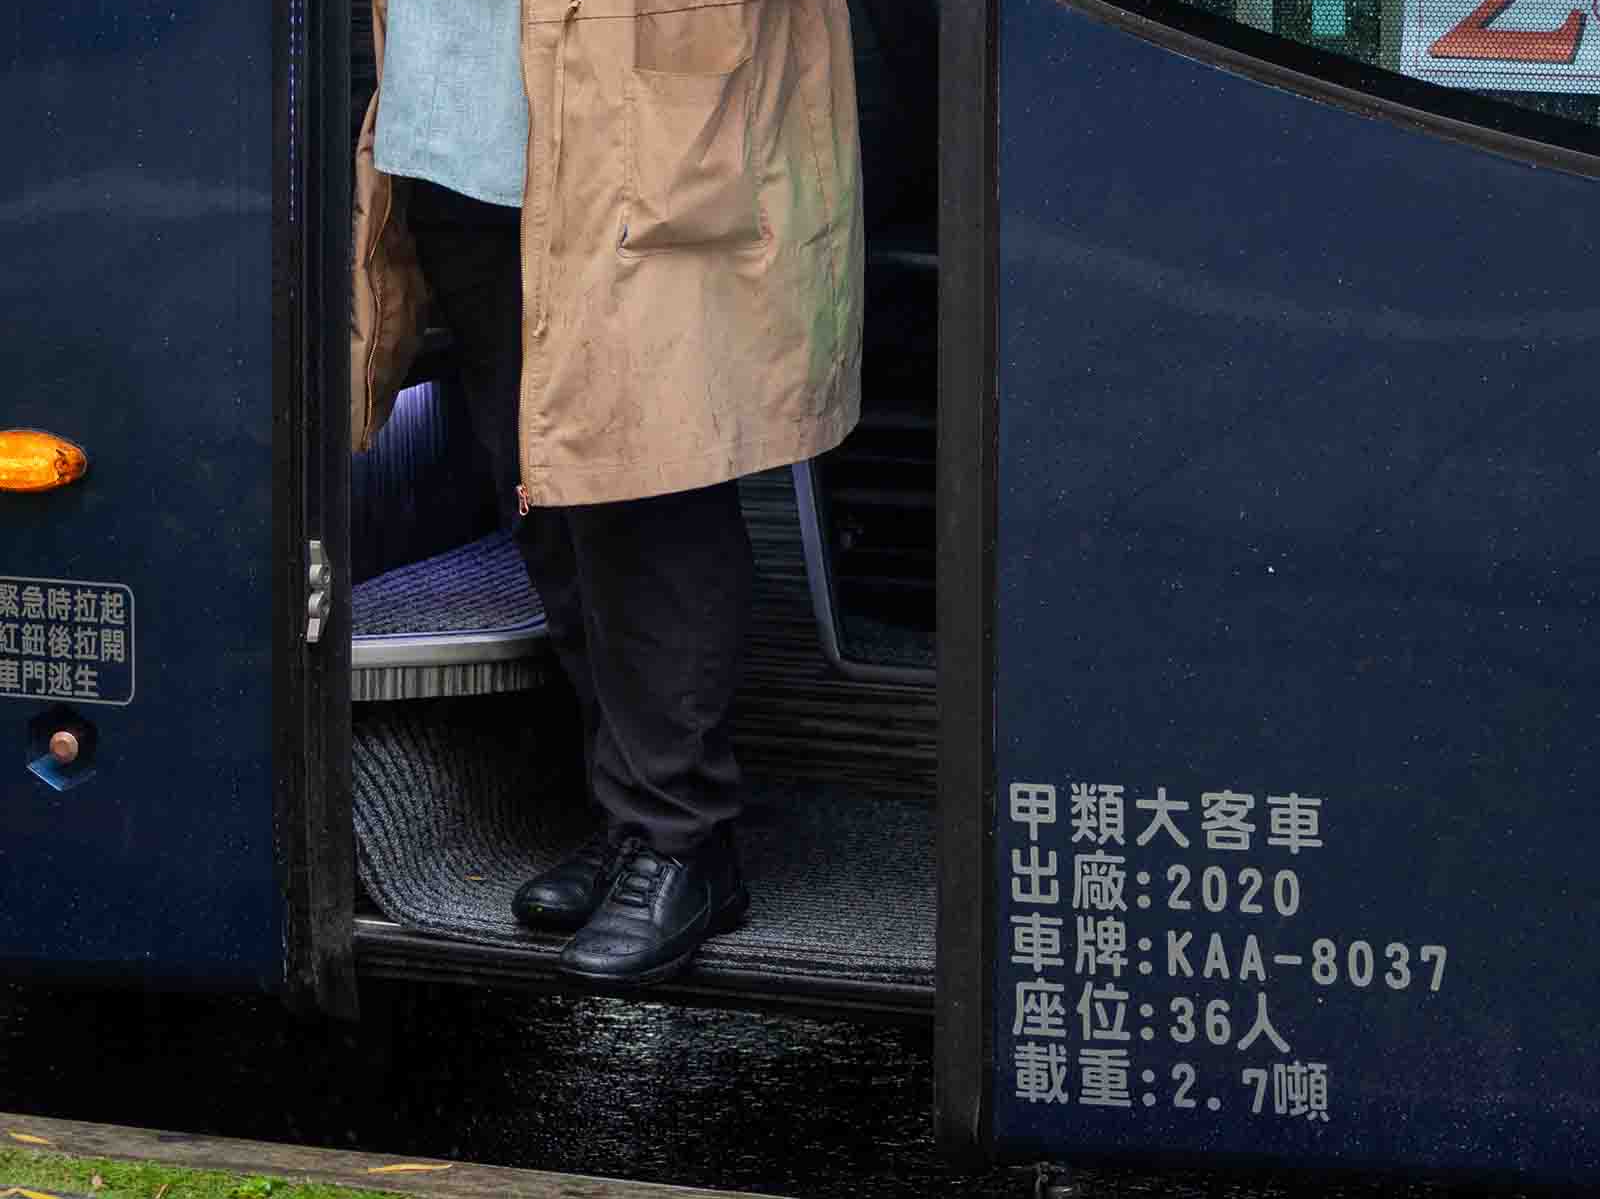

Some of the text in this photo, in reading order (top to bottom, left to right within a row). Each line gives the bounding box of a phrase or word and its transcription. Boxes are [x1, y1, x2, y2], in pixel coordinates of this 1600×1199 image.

[0, 658, 99, 696] 車門逃生
[1009, 782, 1323, 854] 甲類大客車
